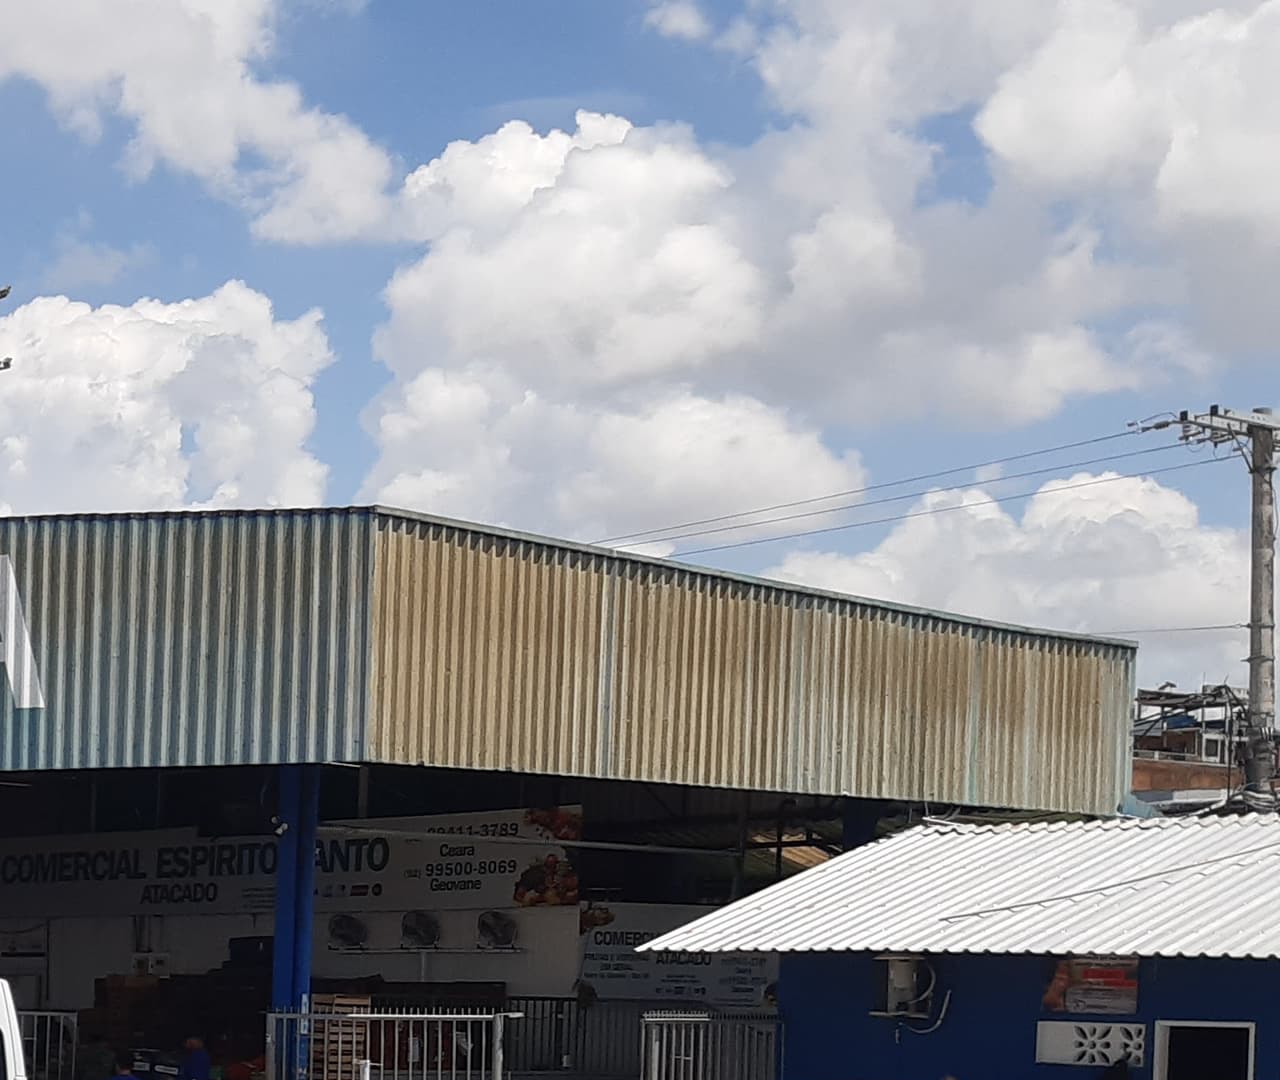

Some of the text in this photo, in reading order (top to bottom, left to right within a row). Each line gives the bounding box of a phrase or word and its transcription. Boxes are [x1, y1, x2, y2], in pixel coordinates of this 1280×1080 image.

[0, 847, 147, 885] COMERCIAL
[313, 836, 391, 874] ANTO
[425, 859, 517, 877] 99500-8069
[139, 883, 219, 905] ATACADO
[430, 878, 482, 892] Geovane
